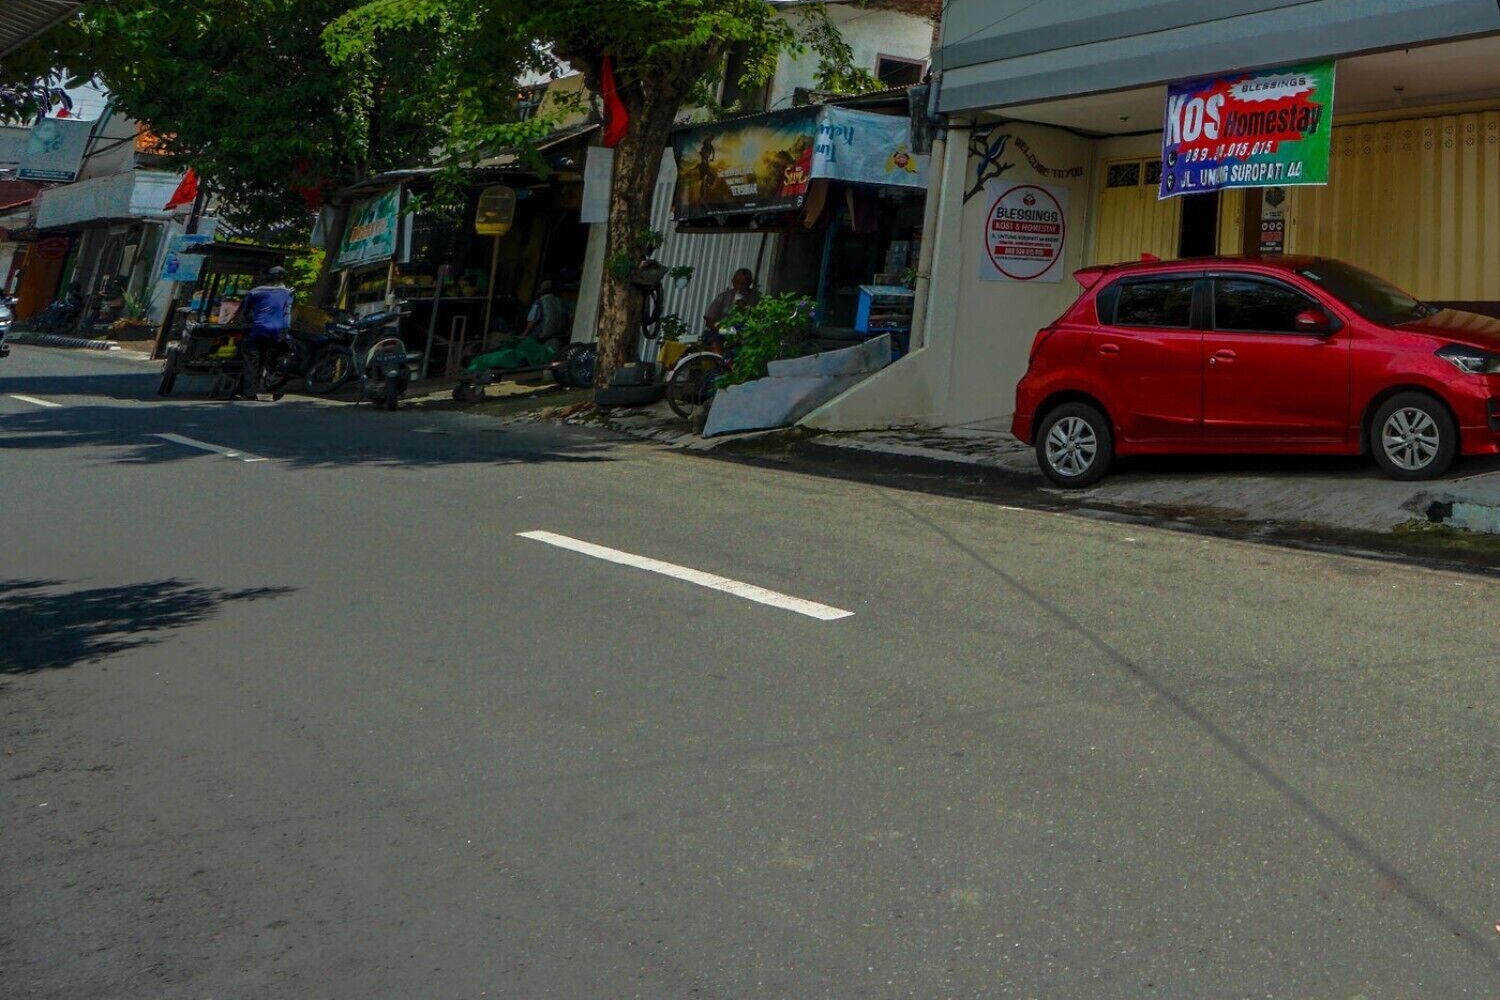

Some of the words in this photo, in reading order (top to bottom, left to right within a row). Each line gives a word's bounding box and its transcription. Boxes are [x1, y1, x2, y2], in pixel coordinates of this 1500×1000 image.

[1241, 76, 1307, 93] BLESSINGS
[1166, 93, 1225, 147] KOS
[1223, 104, 1323, 137] Homestay
[1052, 169, 1063, 179] TO
[1063, 166, 1084, 178] YOU
[1180, 170, 1196, 188] JL.
[1231, 163, 1284, 182] SUROPATI
[996, 206, 1059, 223] BLESSINGS
[994, 222, 1014, 231] KOST
[1021, 223, 1058, 233] HOMESTAY
